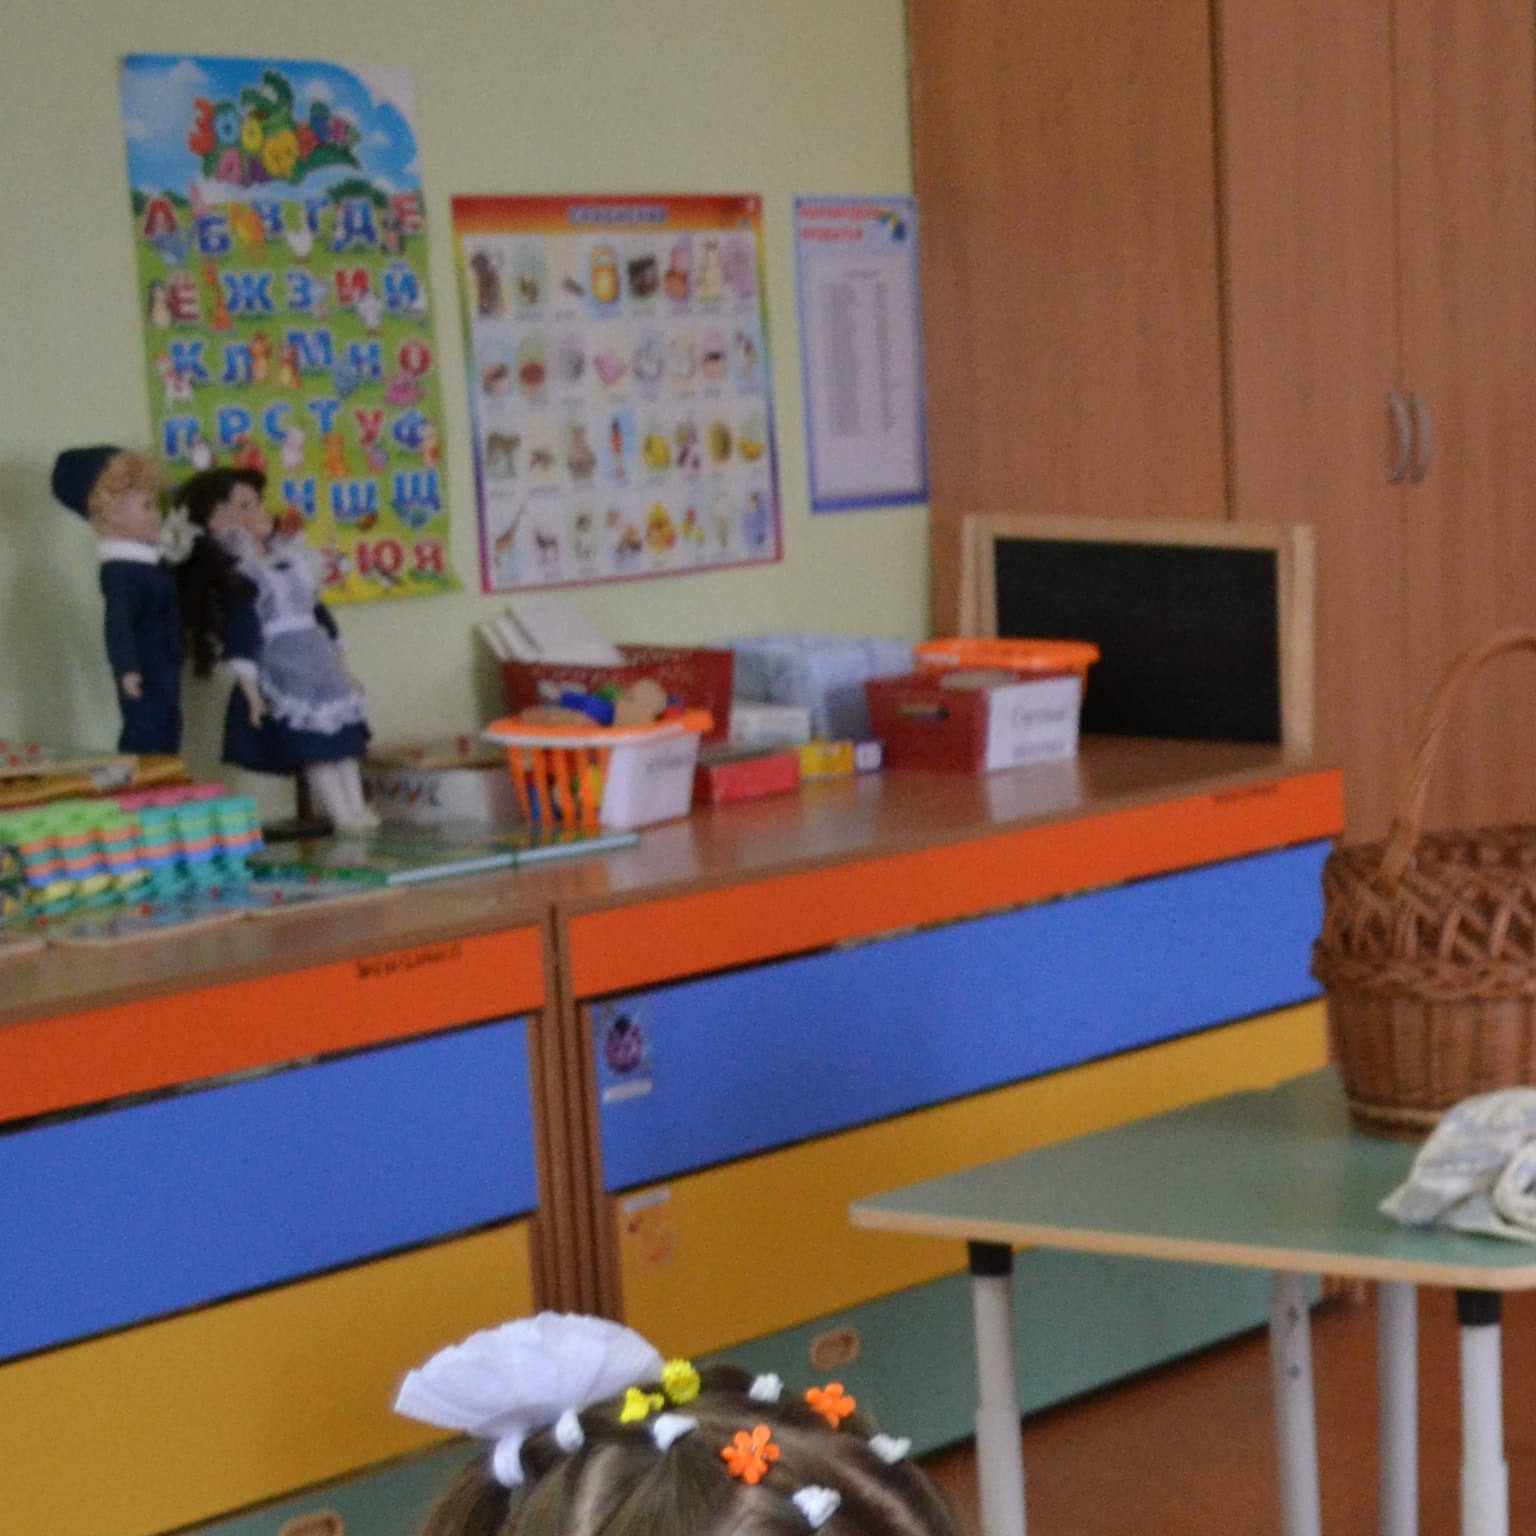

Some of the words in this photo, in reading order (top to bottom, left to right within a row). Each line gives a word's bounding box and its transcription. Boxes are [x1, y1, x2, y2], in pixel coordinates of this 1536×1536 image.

[196, 214, 232, 256] Б
[332, 197, 378, 252] Д
[223, 272, 276, 313] Ж
[398, 339, 431, 378] О
[217, 404, 252, 446] Р
[354, 408, 385, 446] У
[330, 479, 379, 523] Ш
[357, 538, 407, 577] Ю
[414, 539, 445, 576] Я
